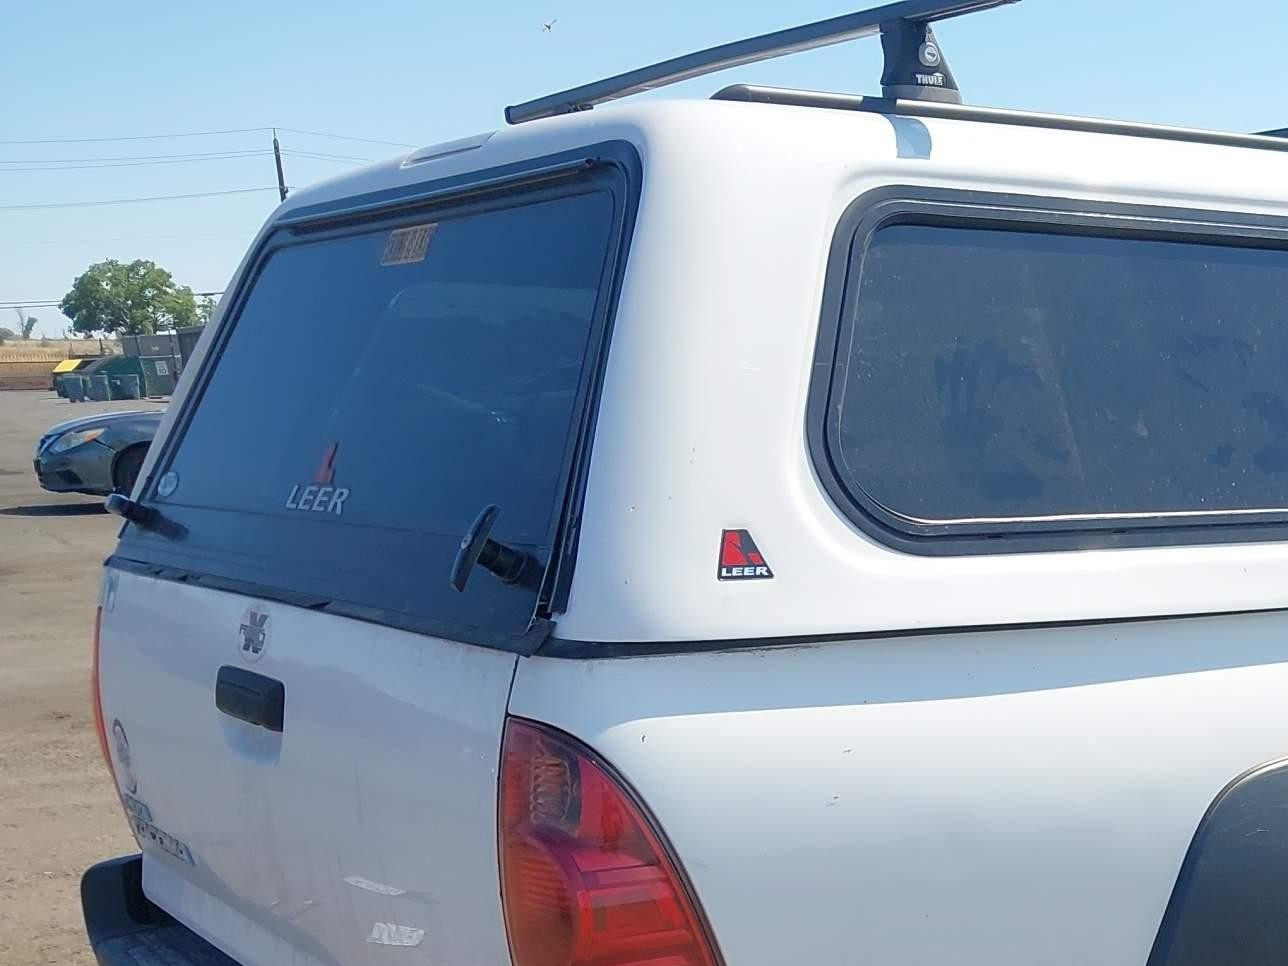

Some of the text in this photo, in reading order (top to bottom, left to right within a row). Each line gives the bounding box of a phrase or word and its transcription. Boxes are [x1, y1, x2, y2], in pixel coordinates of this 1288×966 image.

[915, 73, 944, 86] THULE
[285, 484, 350, 515] LEER
[721, 566, 769, 577] LEER
